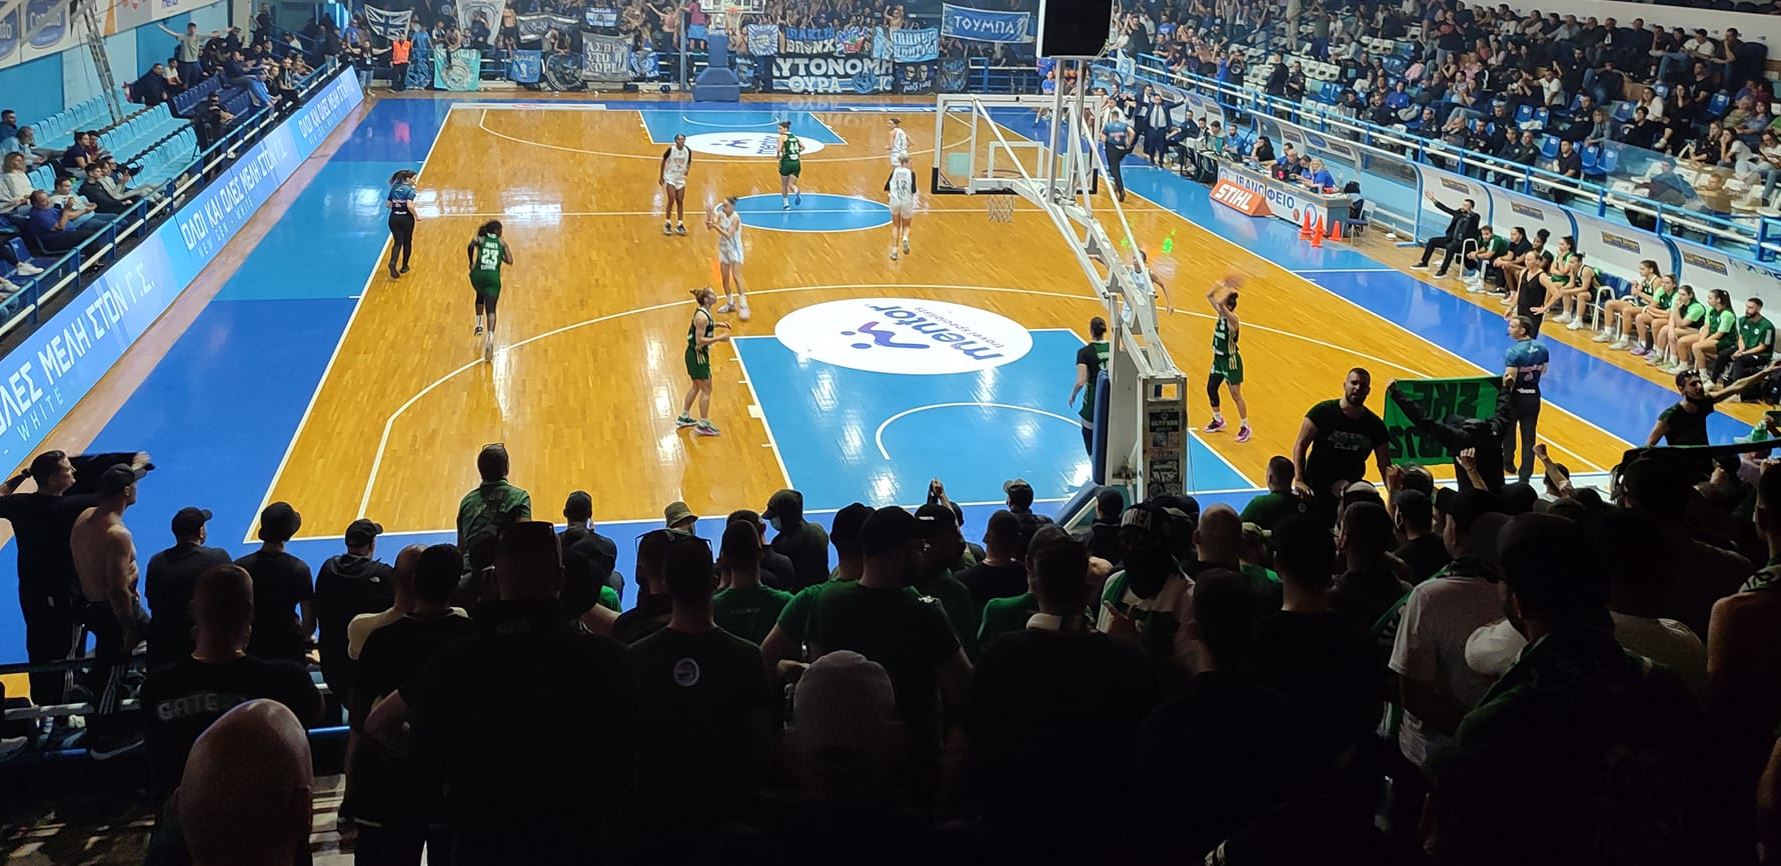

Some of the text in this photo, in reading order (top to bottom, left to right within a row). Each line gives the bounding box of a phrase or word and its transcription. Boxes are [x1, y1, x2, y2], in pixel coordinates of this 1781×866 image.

[954, 15, 1015, 34] ΤΟΥΜΠΑ
[181, 210, 209, 251] ΟΛΟΙ
[204, 195, 224, 229] ΚΑΙ
[219, 176, 244, 213] ΟΛΕΣ
[1215, 183, 1253, 211] STIHL
[481, 248, 499, 265] 23
[37, 317, 92, 386] ΜΕΛΗ
[85, 285, 129, 341] ΣΤΟΝ
[869, 304, 1004, 360] mentor
[16, 386, 65, 442] WHITE
